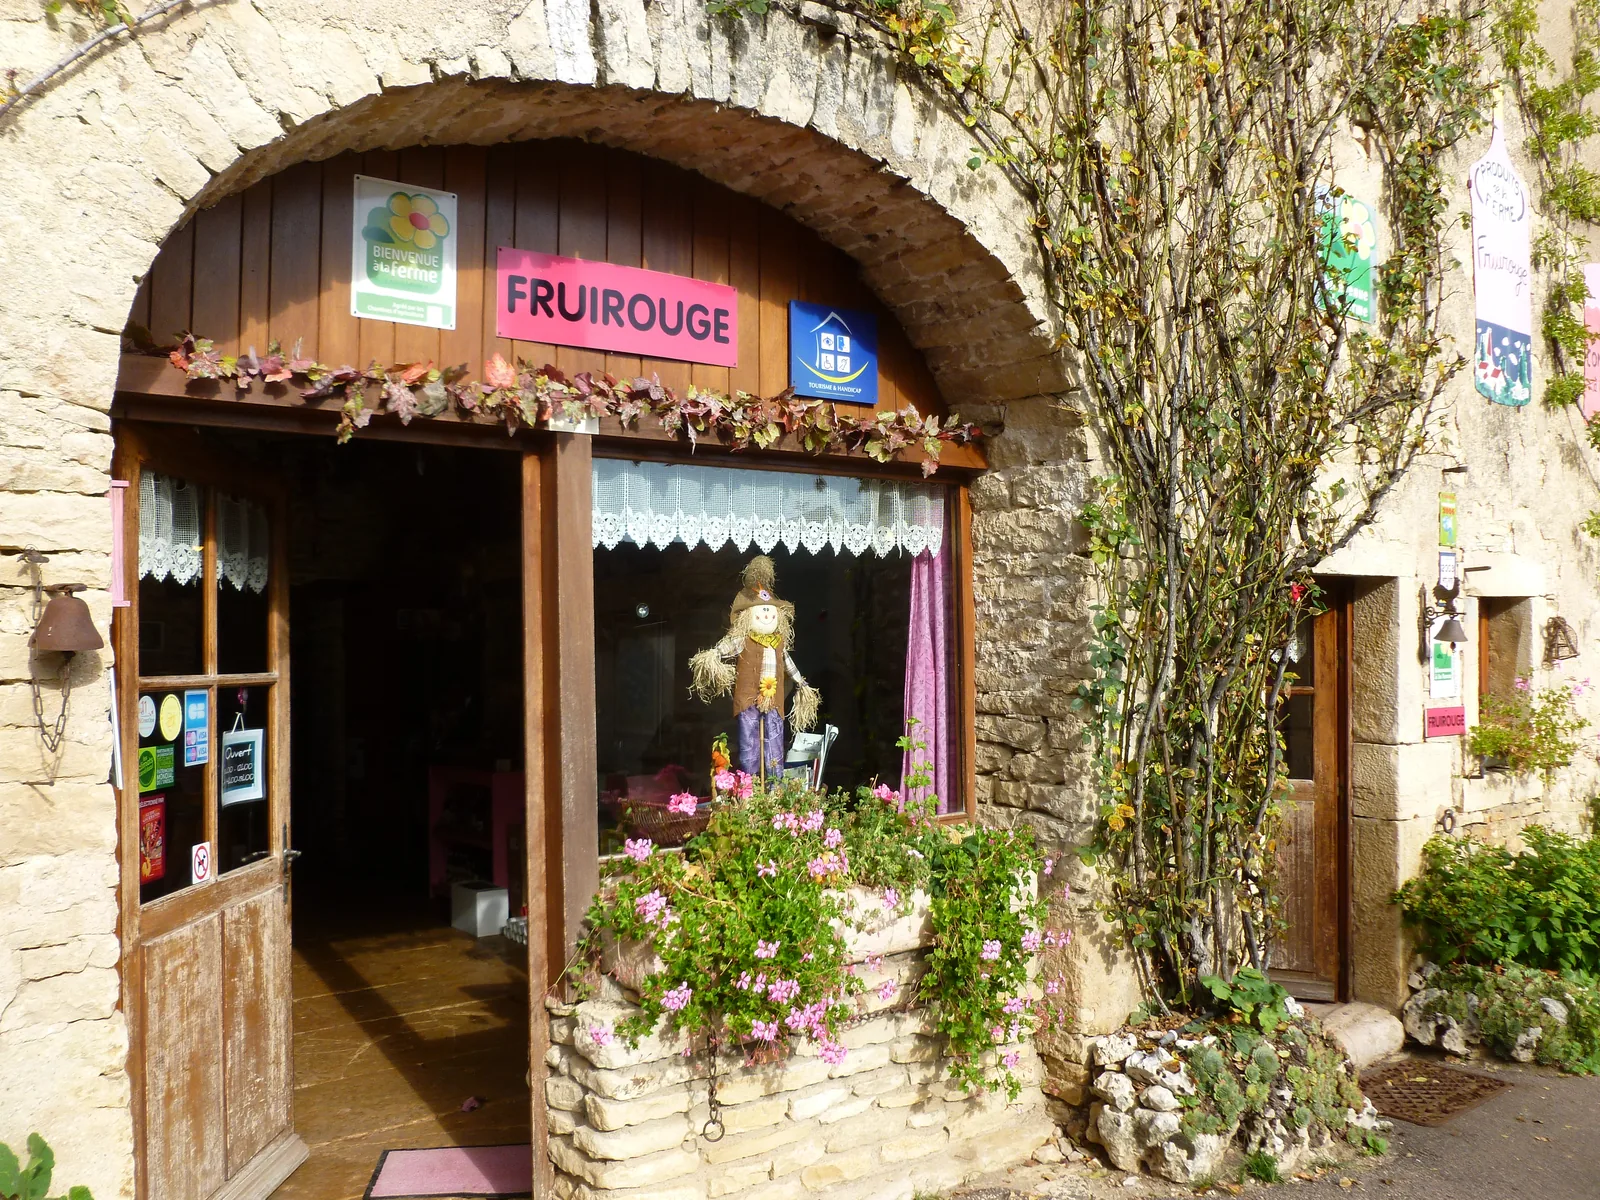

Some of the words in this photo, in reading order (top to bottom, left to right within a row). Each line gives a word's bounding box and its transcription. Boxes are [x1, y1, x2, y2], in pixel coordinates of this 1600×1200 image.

[1480, 162, 1520, 196] PRODUITS
[1486, 193, 1516, 222] FERME
[373, 245, 439, 267] BIENVENUE
[373, 260, 379, 271] à
[380, 261, 390, 273] la
[391, 260, 438, 283] ferme
[508, 274, 730, 345] FRUIROUGE
[808, 382, 832, 390] TOURISME
[838, 386, 862, 394] HANDICAP
[1428, 715, 1464, 728] FRUIROUGE
[199, 731, 207, 739] VISA
[199, 747, 207, 755] VISA
[225, 744, 252, 760] Ouvert
